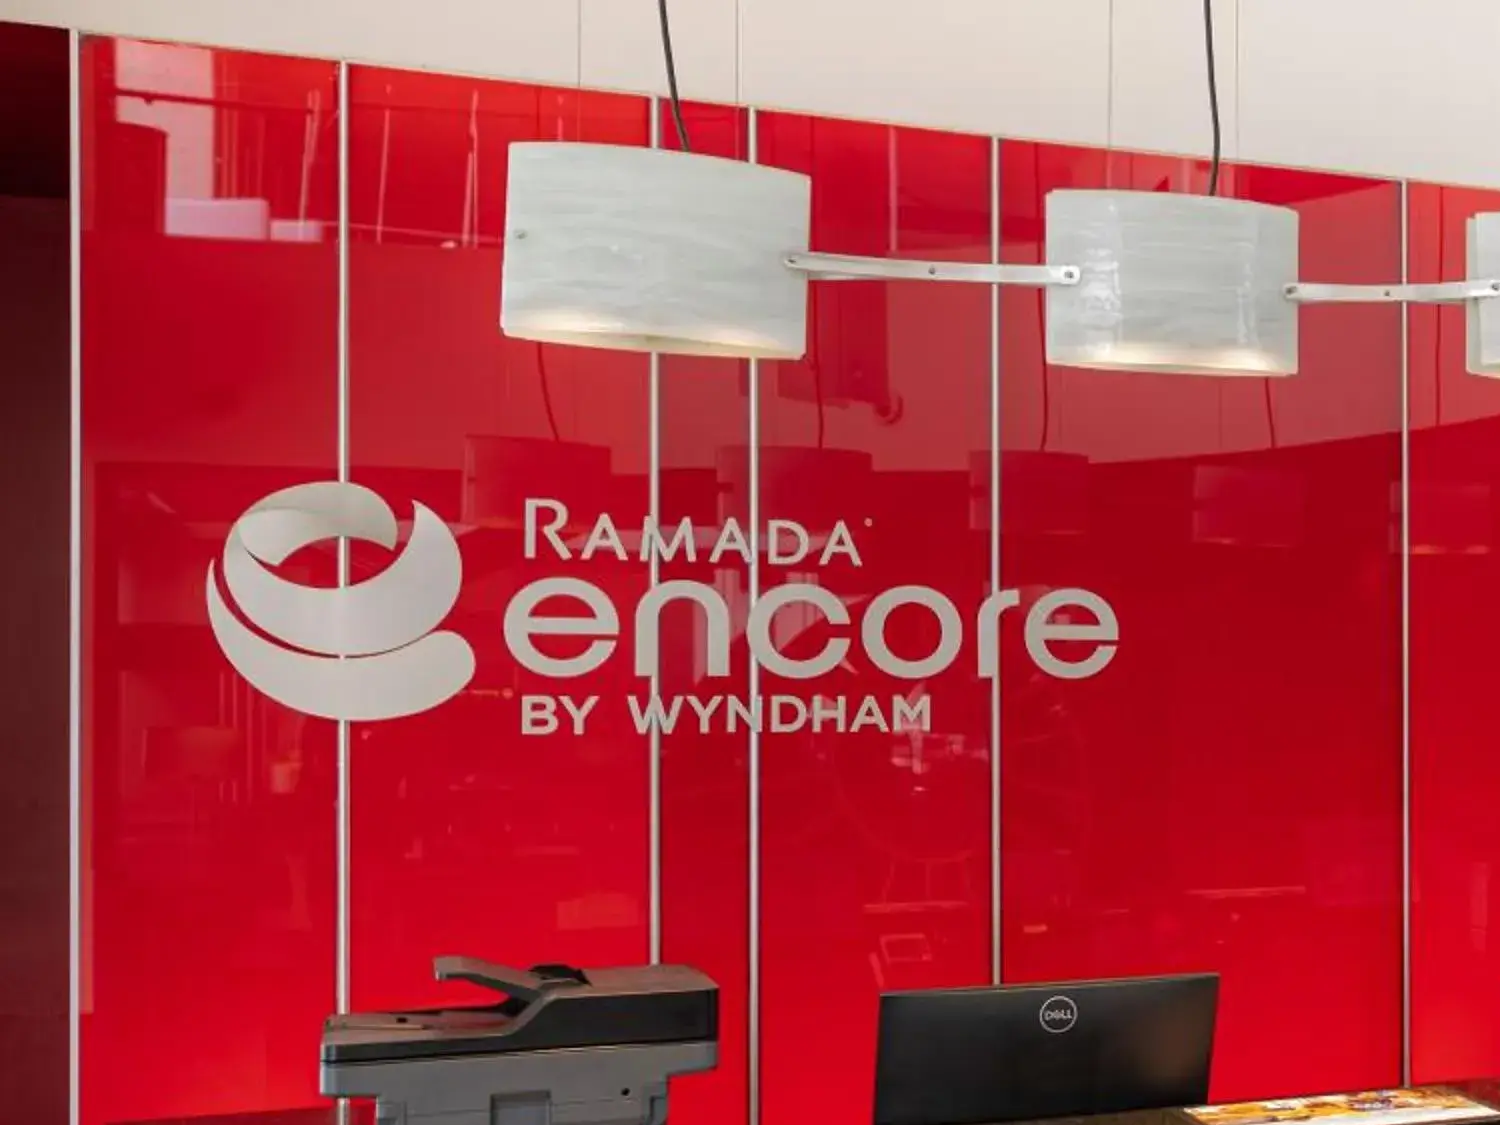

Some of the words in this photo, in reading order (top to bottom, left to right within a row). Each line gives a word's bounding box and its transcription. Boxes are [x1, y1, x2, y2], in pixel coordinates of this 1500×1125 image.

[524, 497, 863, 567] RAMADA
[503, 576, 1120, 679] encore
[520, 695, 600, 736] BY
[627, 694, 932, 735] WYNDHAM
